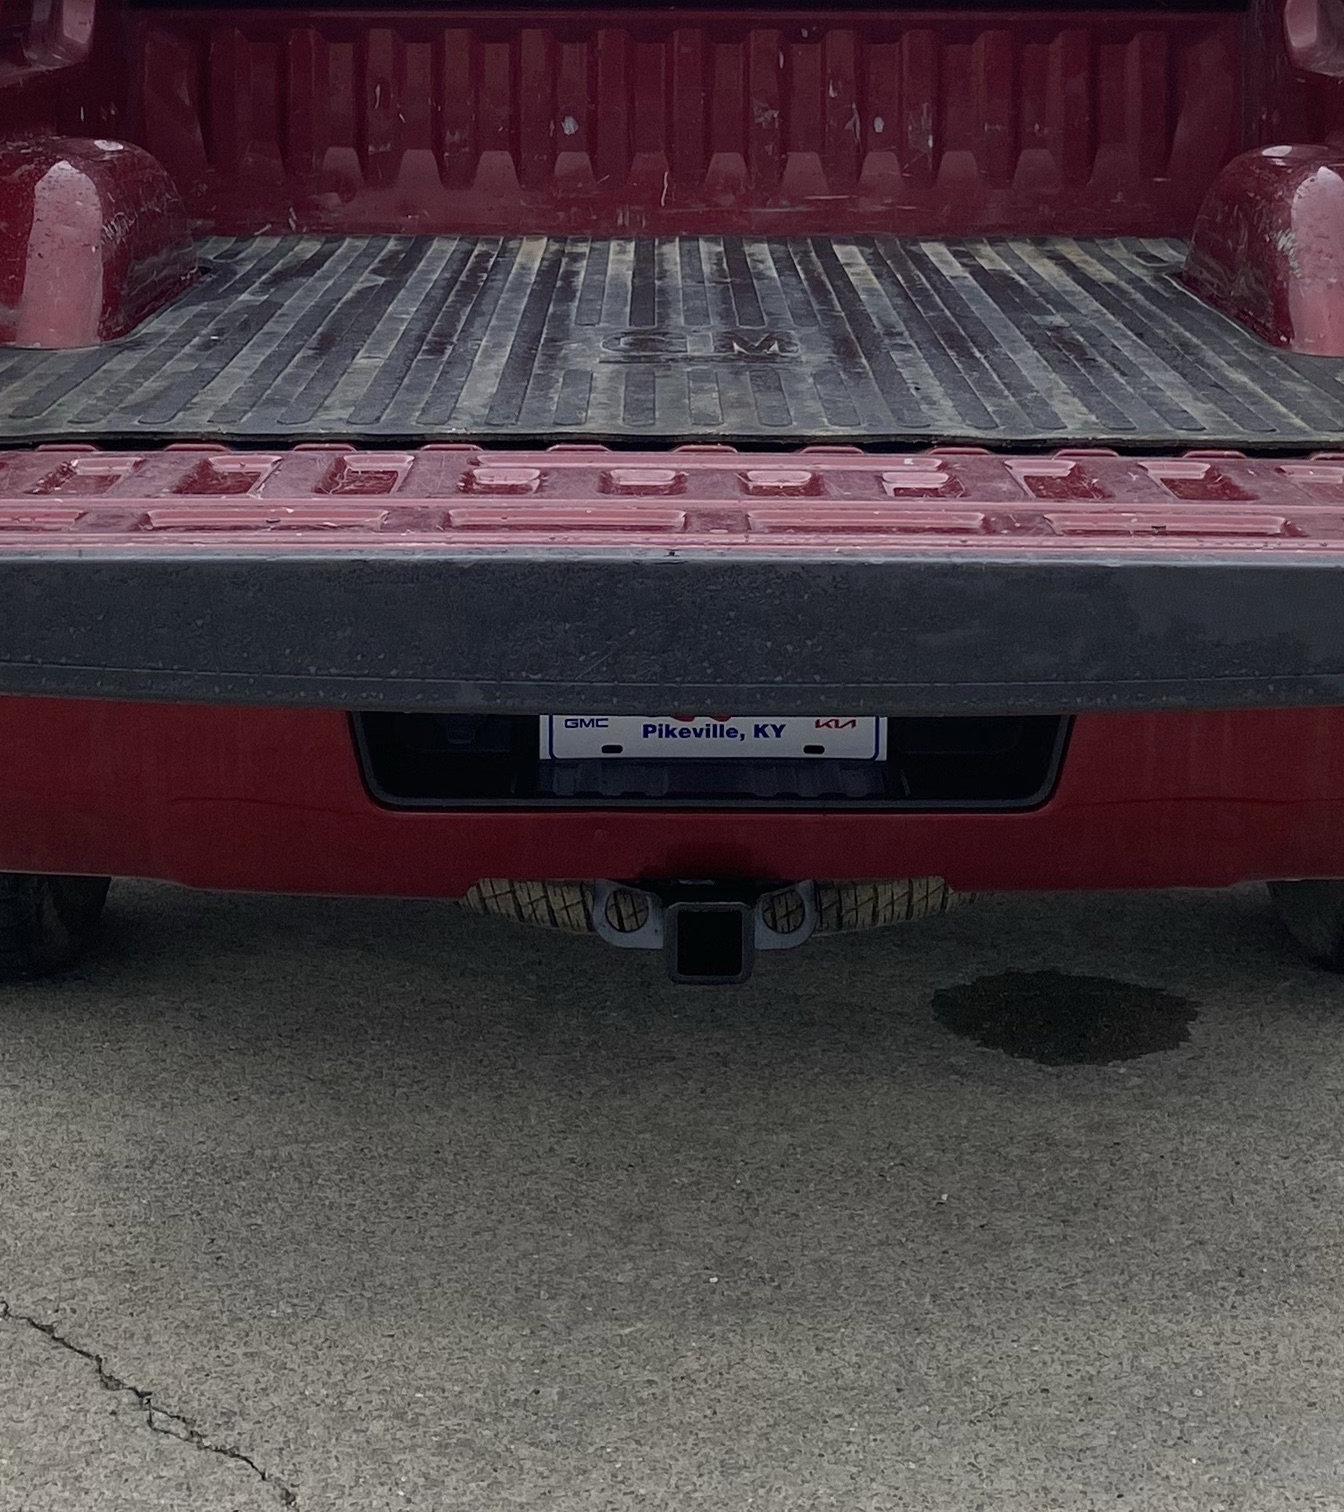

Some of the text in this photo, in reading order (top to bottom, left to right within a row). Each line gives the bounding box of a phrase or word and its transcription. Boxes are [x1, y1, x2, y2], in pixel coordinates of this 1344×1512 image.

[564, 718, 609, 729] GMC
[814, 718, 857, 729] KIA
[642, 723, 787, 742] Pikeville, KY
